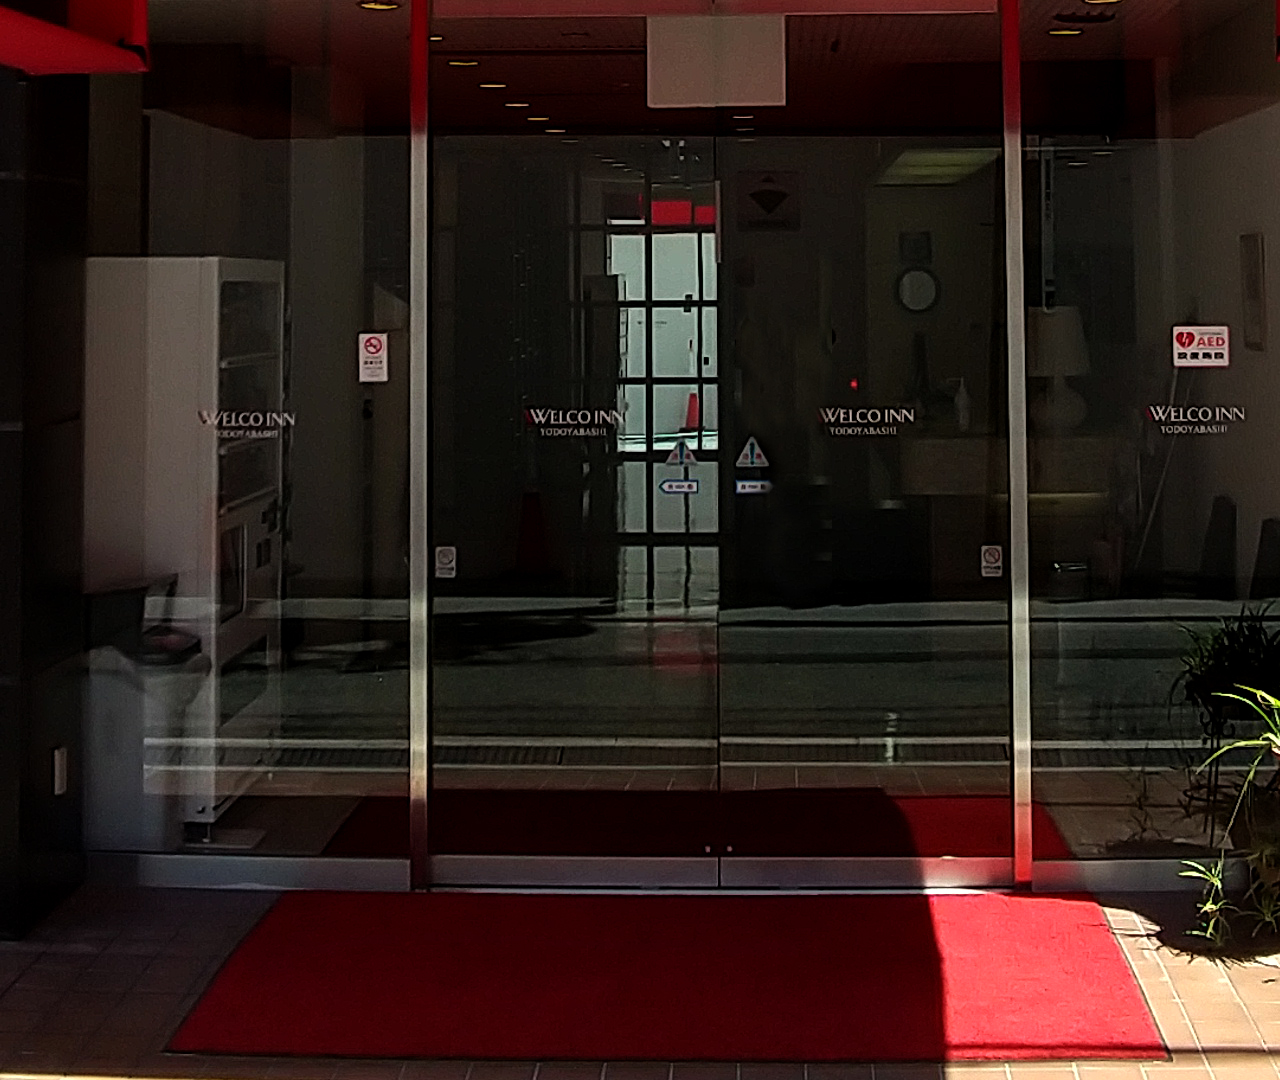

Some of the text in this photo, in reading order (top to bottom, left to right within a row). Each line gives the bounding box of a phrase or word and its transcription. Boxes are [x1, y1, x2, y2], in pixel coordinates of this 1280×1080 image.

[1197, 336, 1225, 347] AED
[266, 412, 295, 426] INN
[526, 407, 625, 424] WELCO INN
[817, 407, 915, 423] WELCO INN
[1145, 405, 1245, 421] WELCO INN
[215, 430, 279, 438] ODOYABASHI
[540, 428, 607, 436] YODOYABASHI
